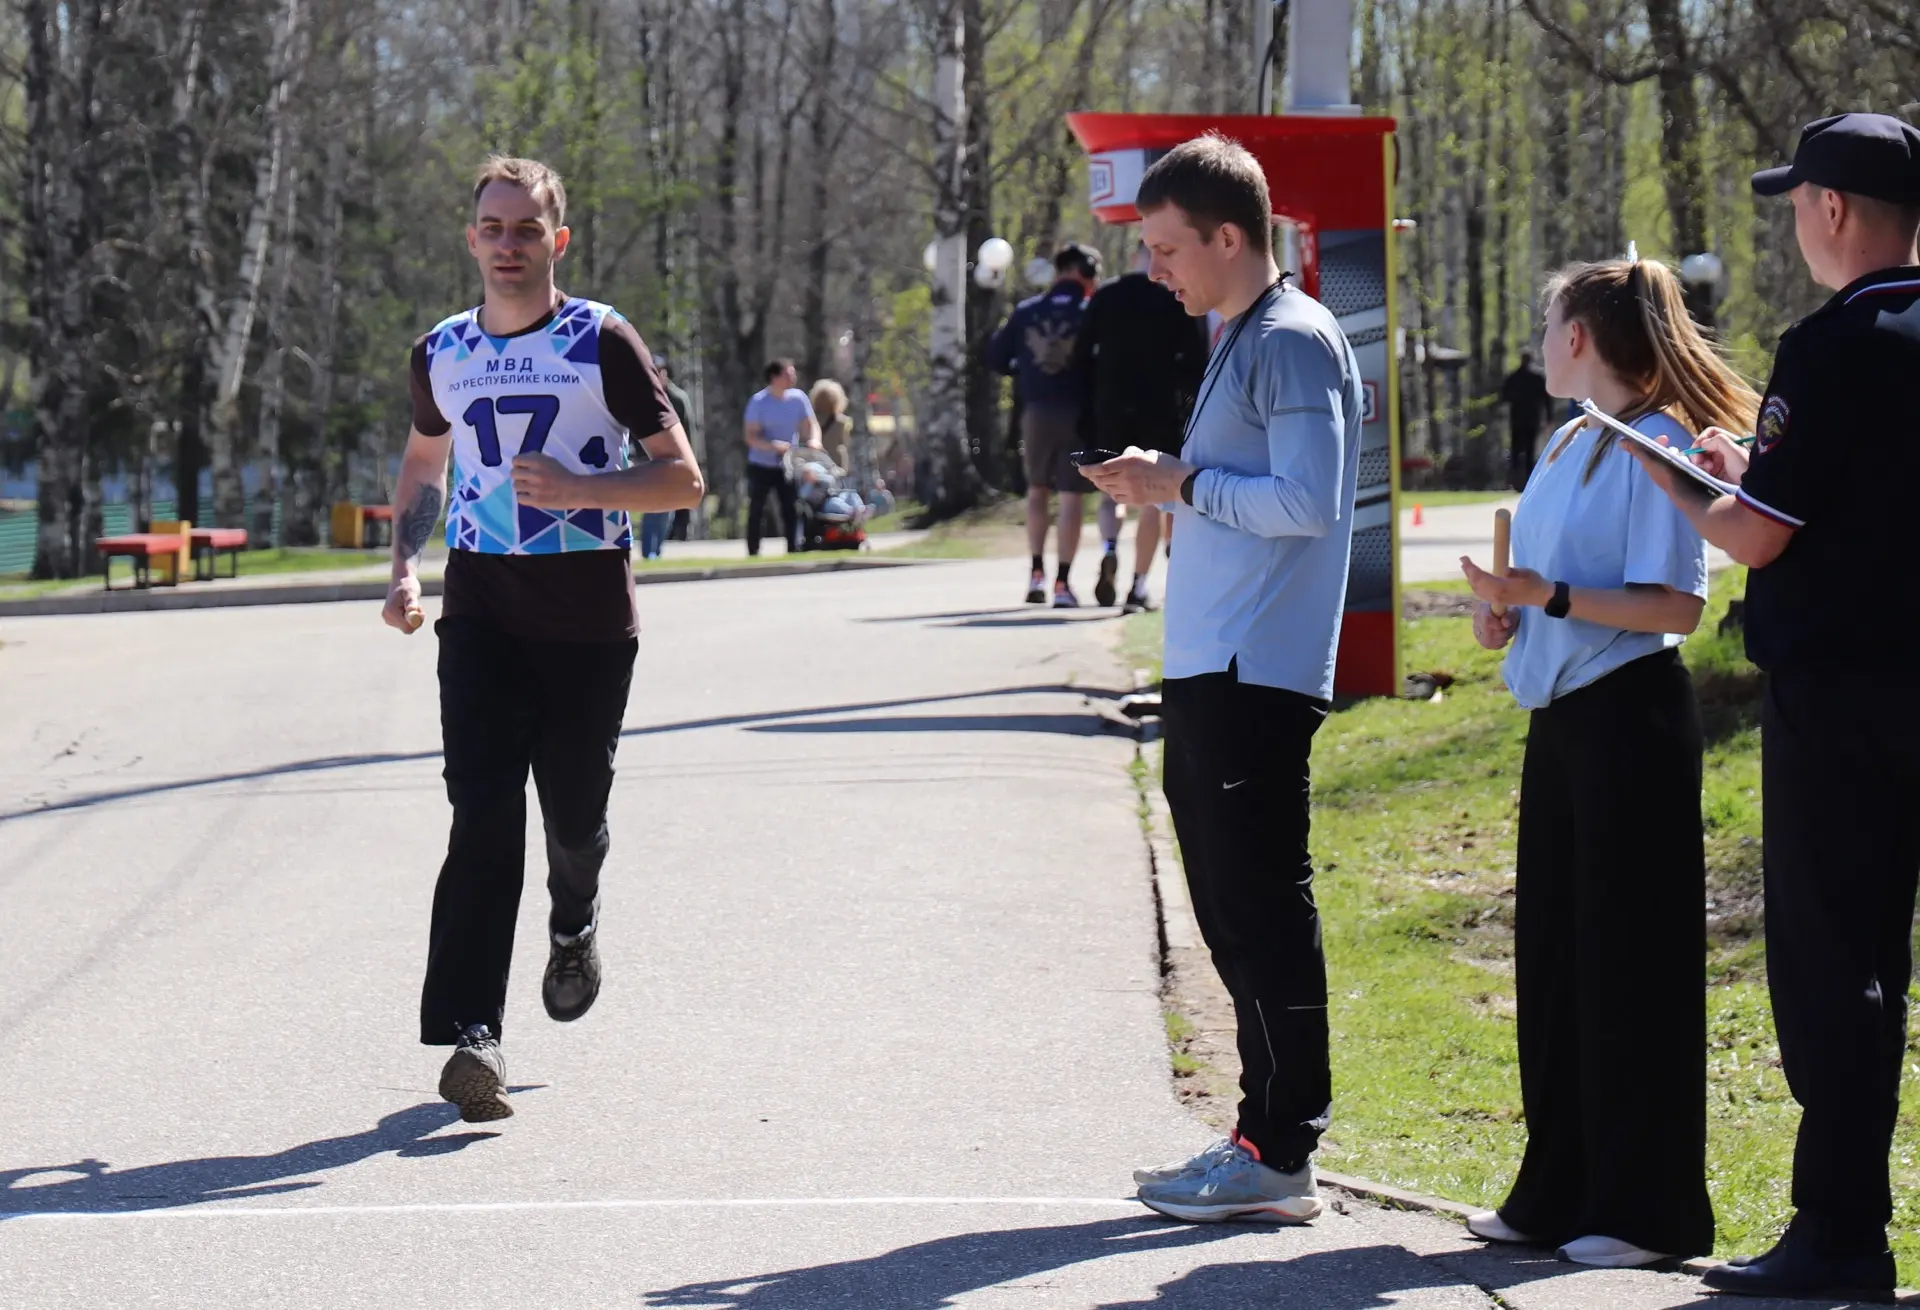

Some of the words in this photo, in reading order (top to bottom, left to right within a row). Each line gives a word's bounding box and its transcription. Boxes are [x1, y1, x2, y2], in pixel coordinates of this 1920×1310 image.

[486, 357, 533, 373] МВД
[462, 373, 541, 389] РЕСПУБЛИКЕ
[543, 374, 580, 384] КОМИ
[462, 394, 560, 467] 17
